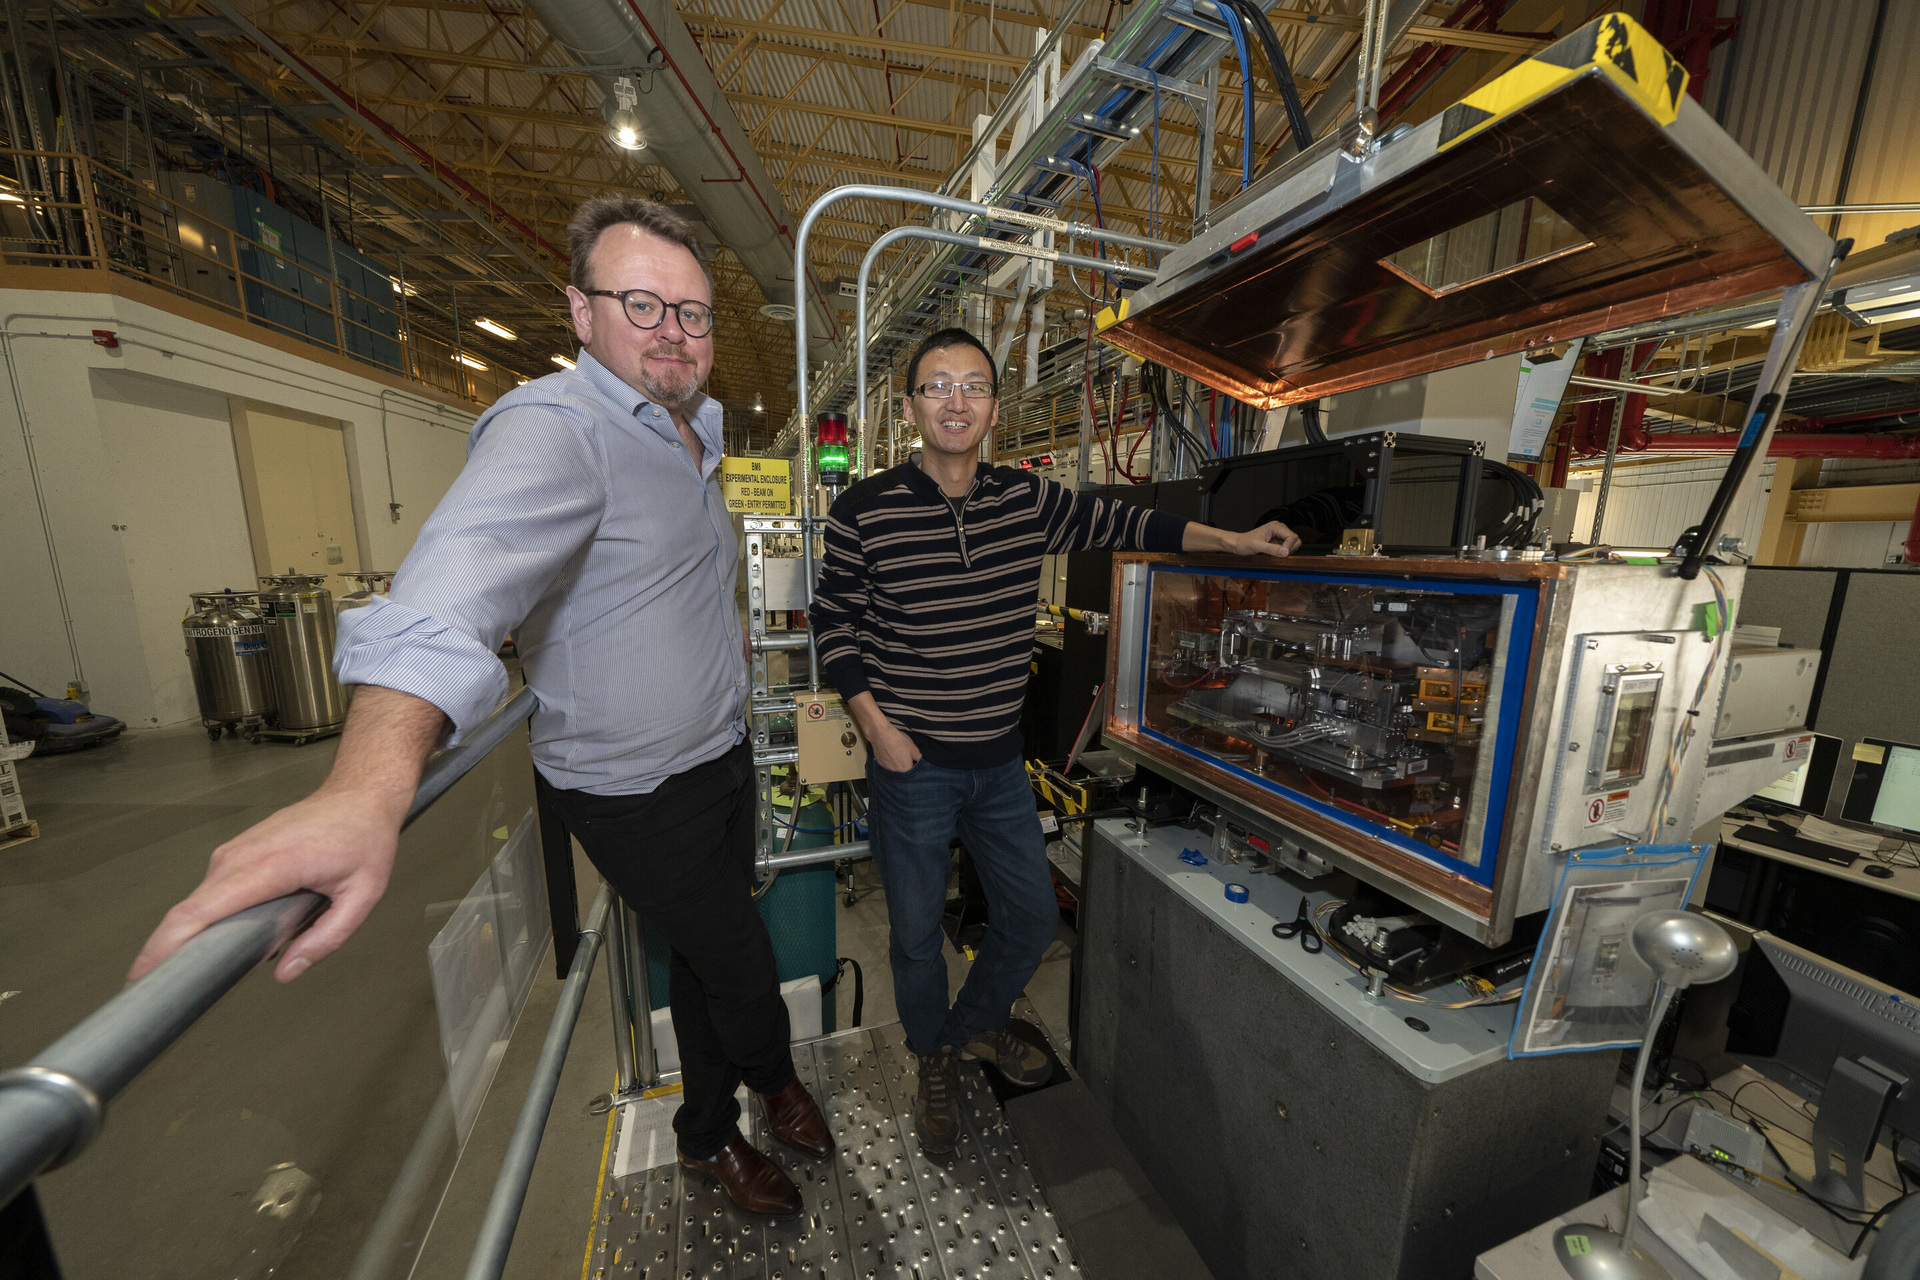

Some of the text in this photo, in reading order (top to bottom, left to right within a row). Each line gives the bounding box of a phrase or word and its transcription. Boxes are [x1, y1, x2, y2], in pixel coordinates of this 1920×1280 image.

[990, 208, 1018, 217] PERSONNEL
[1018, 213, 1046, 224] PROTECTION
[997, 215, 1026, 225] AUTHORIZED
[1026, 220, 1044, 228] ACCESS
[990, 243, 1018, 252] AUTHORIZED
[752, 462, 761, 470] BM8
[726, 474, 787, 484] EXPERIMENTAL ENCLOSURE
[741, 488, 750, 496] RED
[754, 488, 766, 496] BEAM
[767, 488, 774, 496] ON
[729, 500, 744, 508] GREEN
[748, 500, 761, 508] ENTRY
[762, 501, 786, 509] PERMITTED
